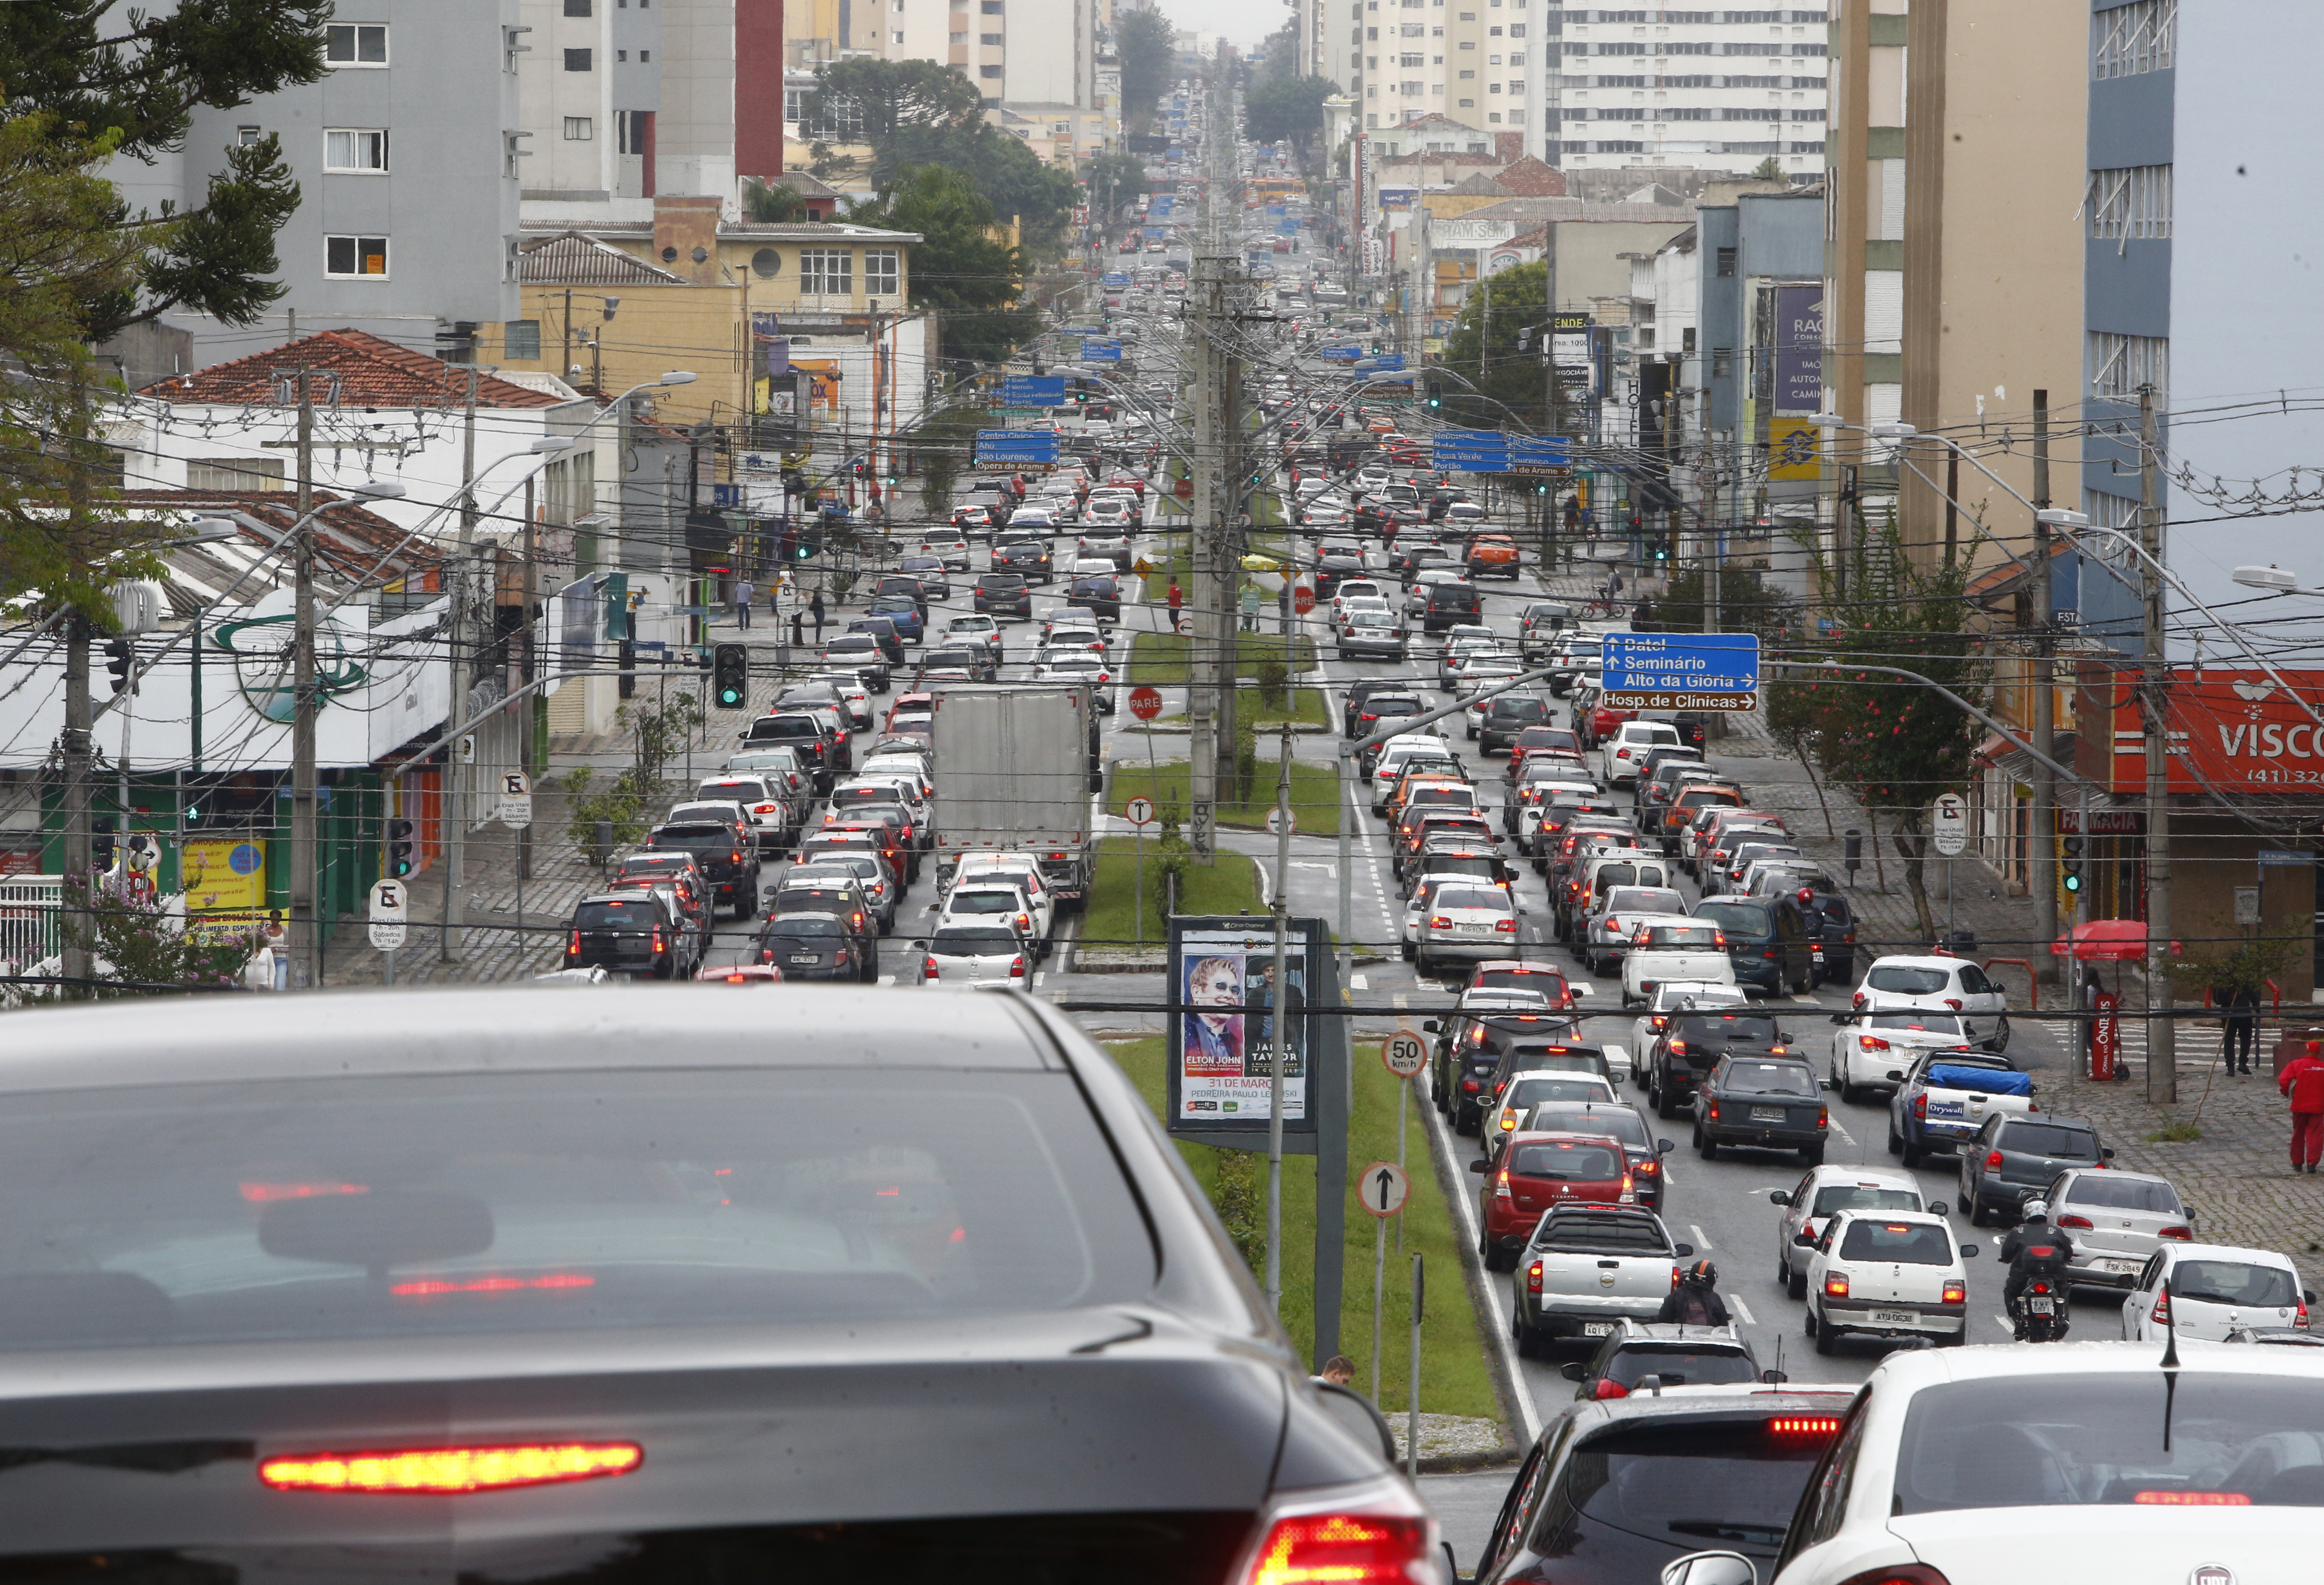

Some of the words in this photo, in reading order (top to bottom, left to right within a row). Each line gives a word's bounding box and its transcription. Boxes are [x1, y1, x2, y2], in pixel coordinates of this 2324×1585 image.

[1628, 380, 1640, 447] HOTEL
[1435, 432, 1474, 441] Rebouças
[1435, 450, 1456, 461] Água
[978, 461, 1002, 471] Ópera
[1295, 596, 1314, 606] ARE
[1625, 638, 1665, 651] Batel
[1625, 656, 1706, 669] Seminário
[1624, 673, 1656, 687] Alto
[1661, 675, 1680, 687] da
[1687, 673, 1734, 687] Glória
[1131, 697, 1160, 709] PARE
[1604, 693, 1648, 709] Hosp.
[1650, 694, 1670, 707] de
[1676, 694, 1737, 708] Clínicas
[2248, 769, 2289, 783] (41)
[1393, 1041, 1418, 1058] 50
[2103, 1045, 2108, 1053] DO
[1186, 1056, 1214, 1064] ELTON
[1209, 1079, 1221, 1088] 31
[1225, 1079, 1238, 1088] DE
[1241, 1079, 1272, 1090] MARÇ
[1930, 1104, 1963, 1114] Drywall
[2106, 1263, 2140, 1273] FSK-2849
